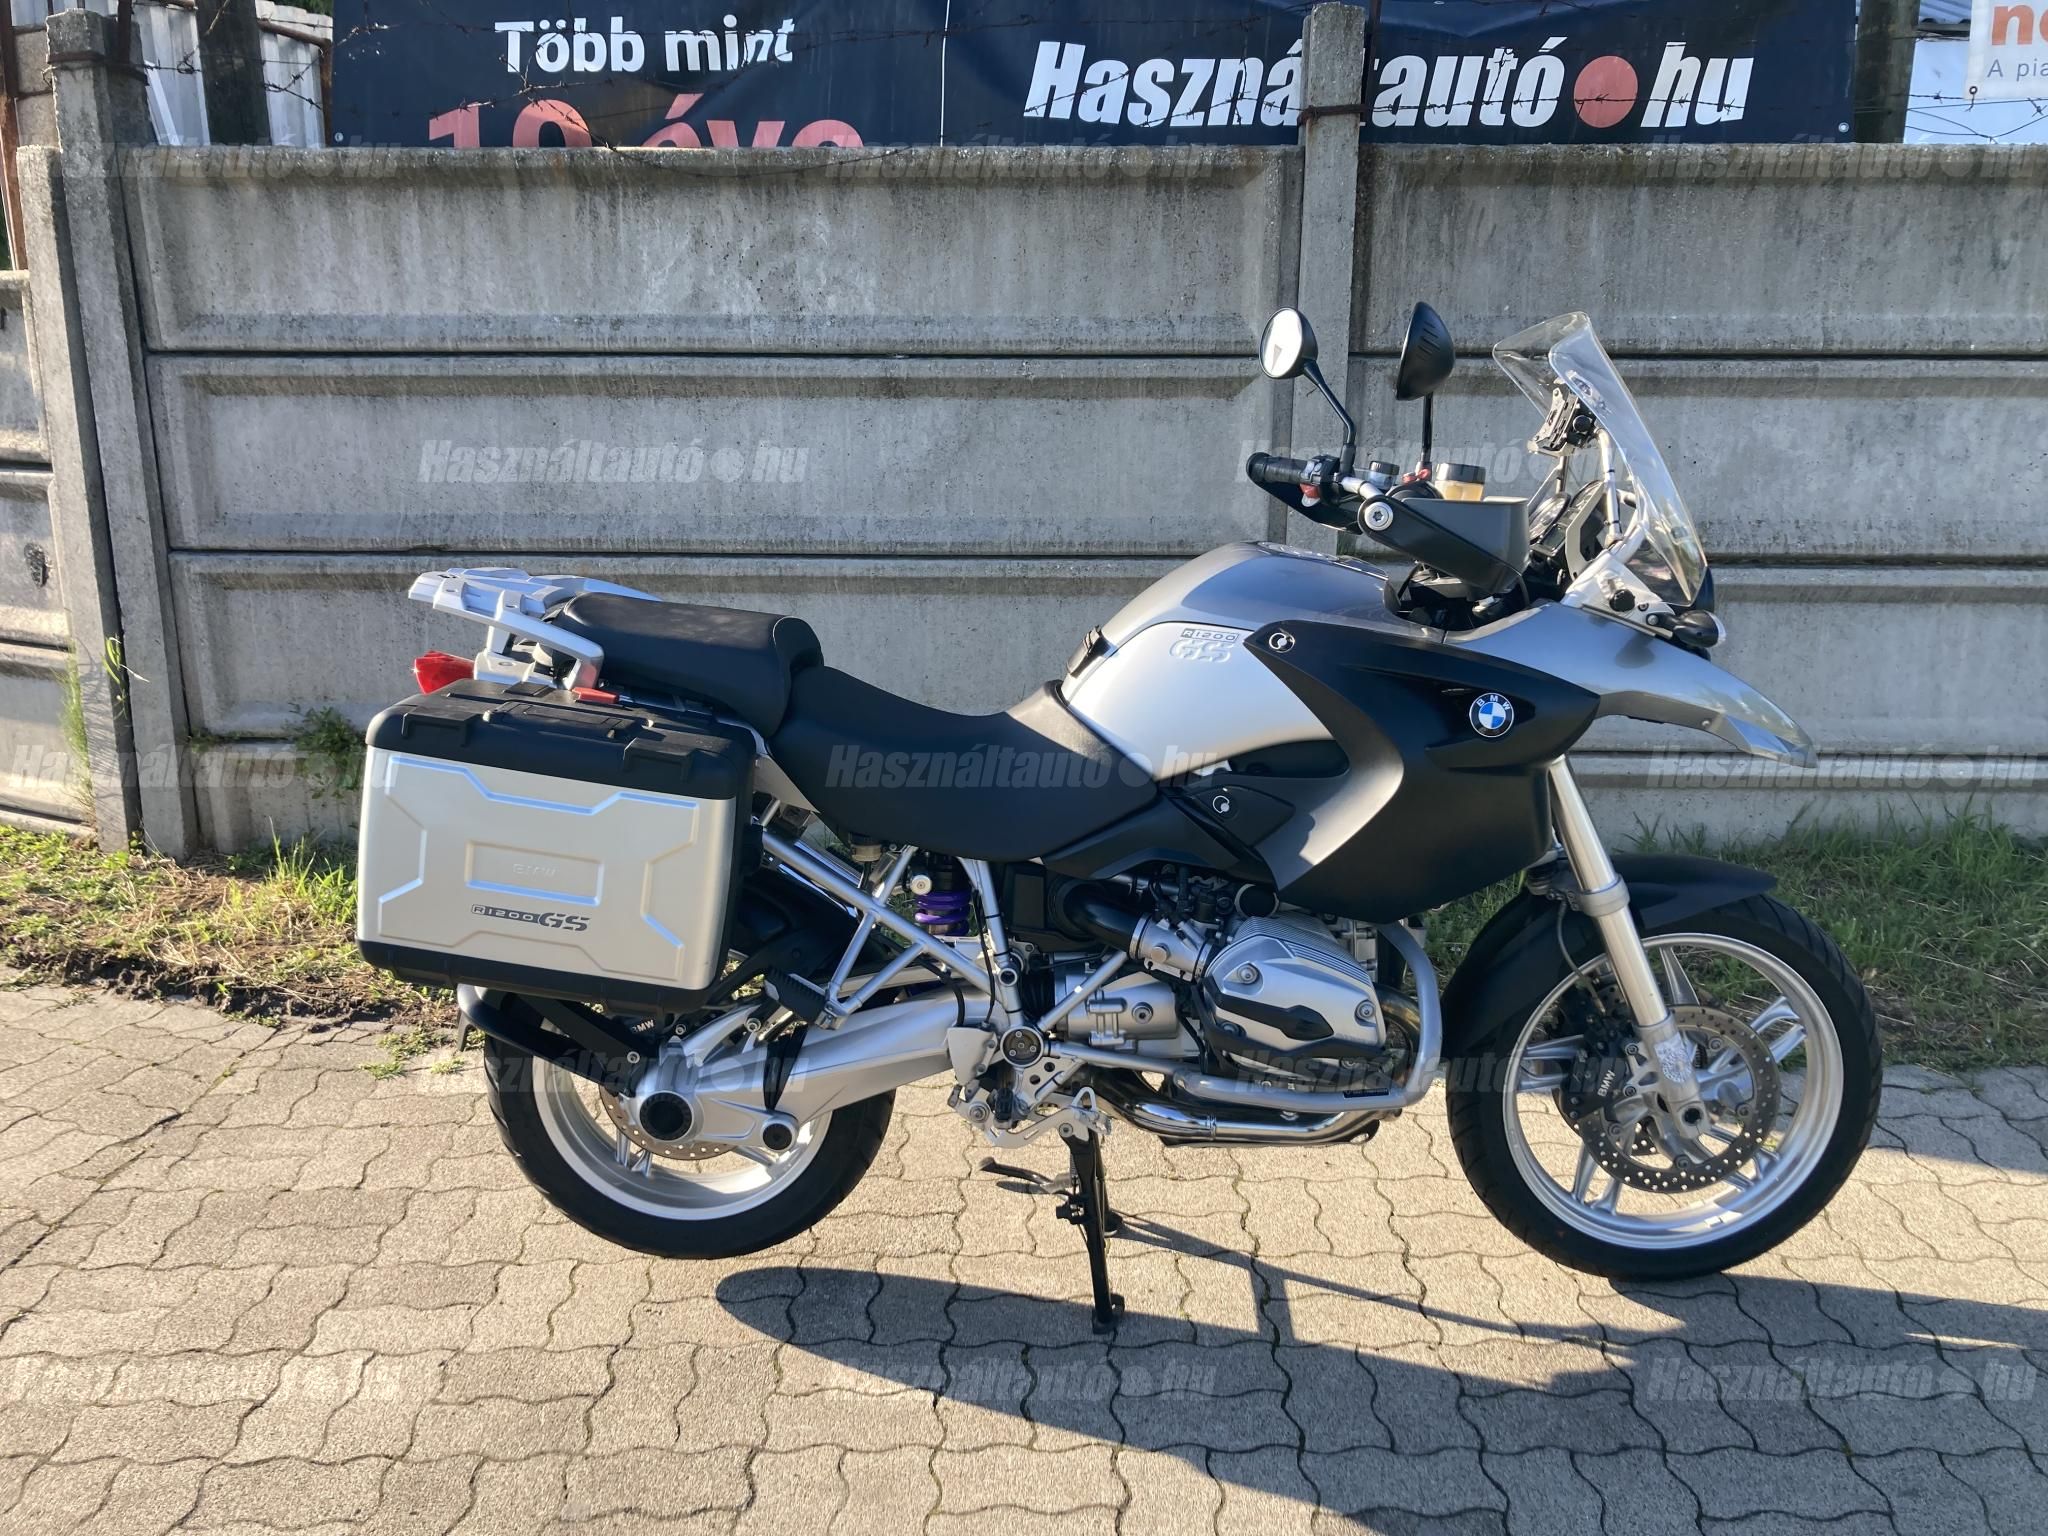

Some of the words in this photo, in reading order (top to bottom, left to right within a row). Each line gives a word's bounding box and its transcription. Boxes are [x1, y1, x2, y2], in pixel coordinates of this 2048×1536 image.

[1991, 4, 2048, 46] n
[494, 16, 645, 73] Több
[664, 14, 795, 72] mint
[1023, 36, 1568, 128] Hasznáautó
[1987, 59, 2004, 77] A
[1476, 694, 1511, 710] BMW
[1597, 1069, 1616, 1097] BMW
